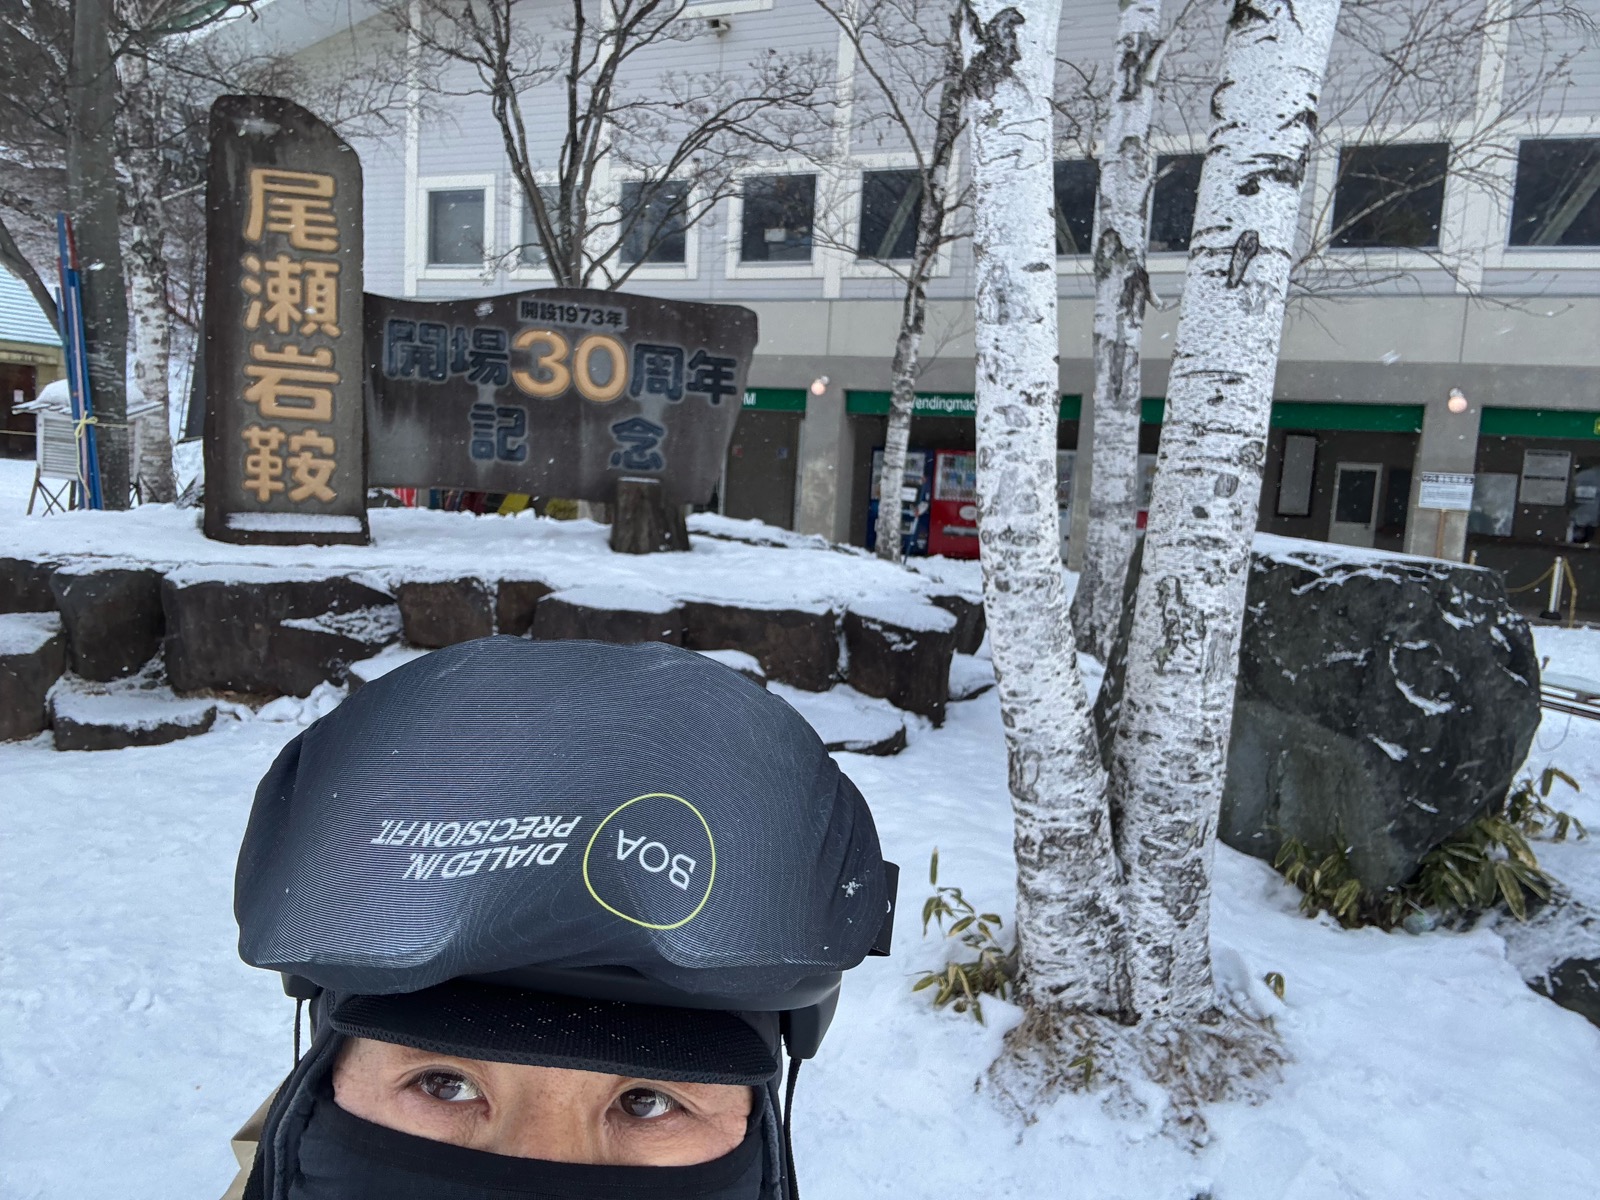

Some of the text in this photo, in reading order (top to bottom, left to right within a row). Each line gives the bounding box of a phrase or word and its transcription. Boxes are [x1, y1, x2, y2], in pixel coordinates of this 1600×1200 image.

[243, 168, 340, 502] 尾瀬岩鞍
[520, 300, 623, 326] 開設1973年
[386, 319, 737, 405] 開場30周年
[370, 815, 582, 848] PRECISION FIT.
[402, 843, 569, 880] DIALED IN.
[617, 829, 697, 890] BOA
